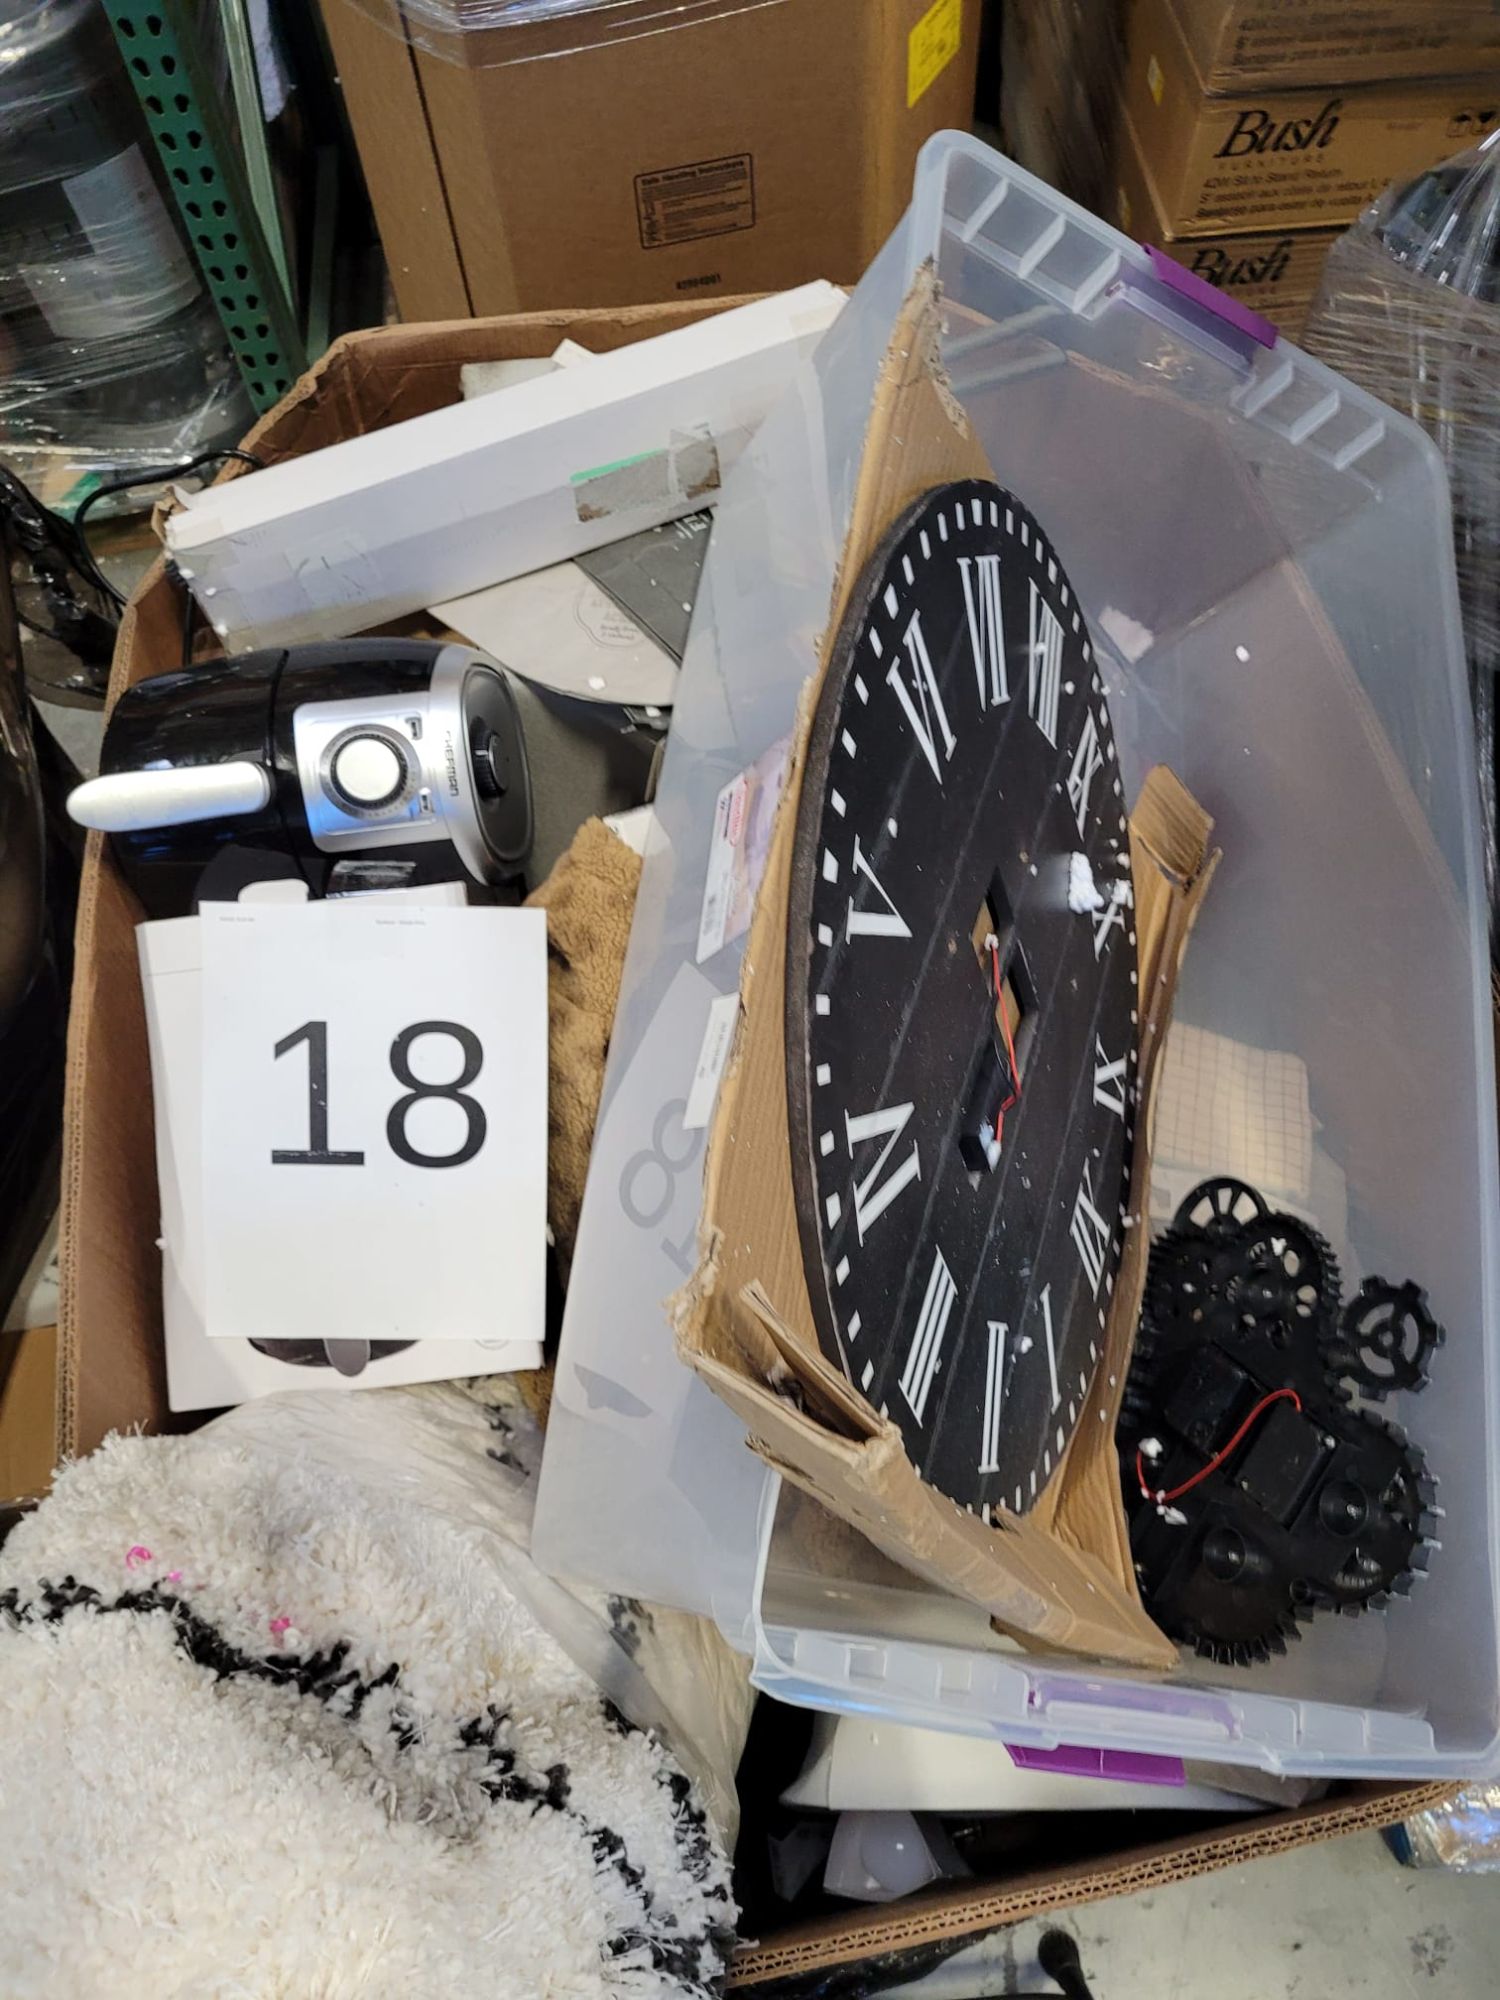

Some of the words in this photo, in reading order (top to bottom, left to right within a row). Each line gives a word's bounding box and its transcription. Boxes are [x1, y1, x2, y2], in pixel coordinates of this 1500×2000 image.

[1213, 98, 1342, 158] Bush
[1191, 239, 1295, 287] Bush
[885, 607, 958, 786] VI
[957, 554, 1011, 712] VII
[845, 833, 913, 945] V
[271, 1019, 488, 1169] 18
[843, 1101, 922, 1248] IV
[897, 1243, 959, 1430] III
[977, 1319, 1010, 1475] II
[1039, 1282, 1062, 1415] I
